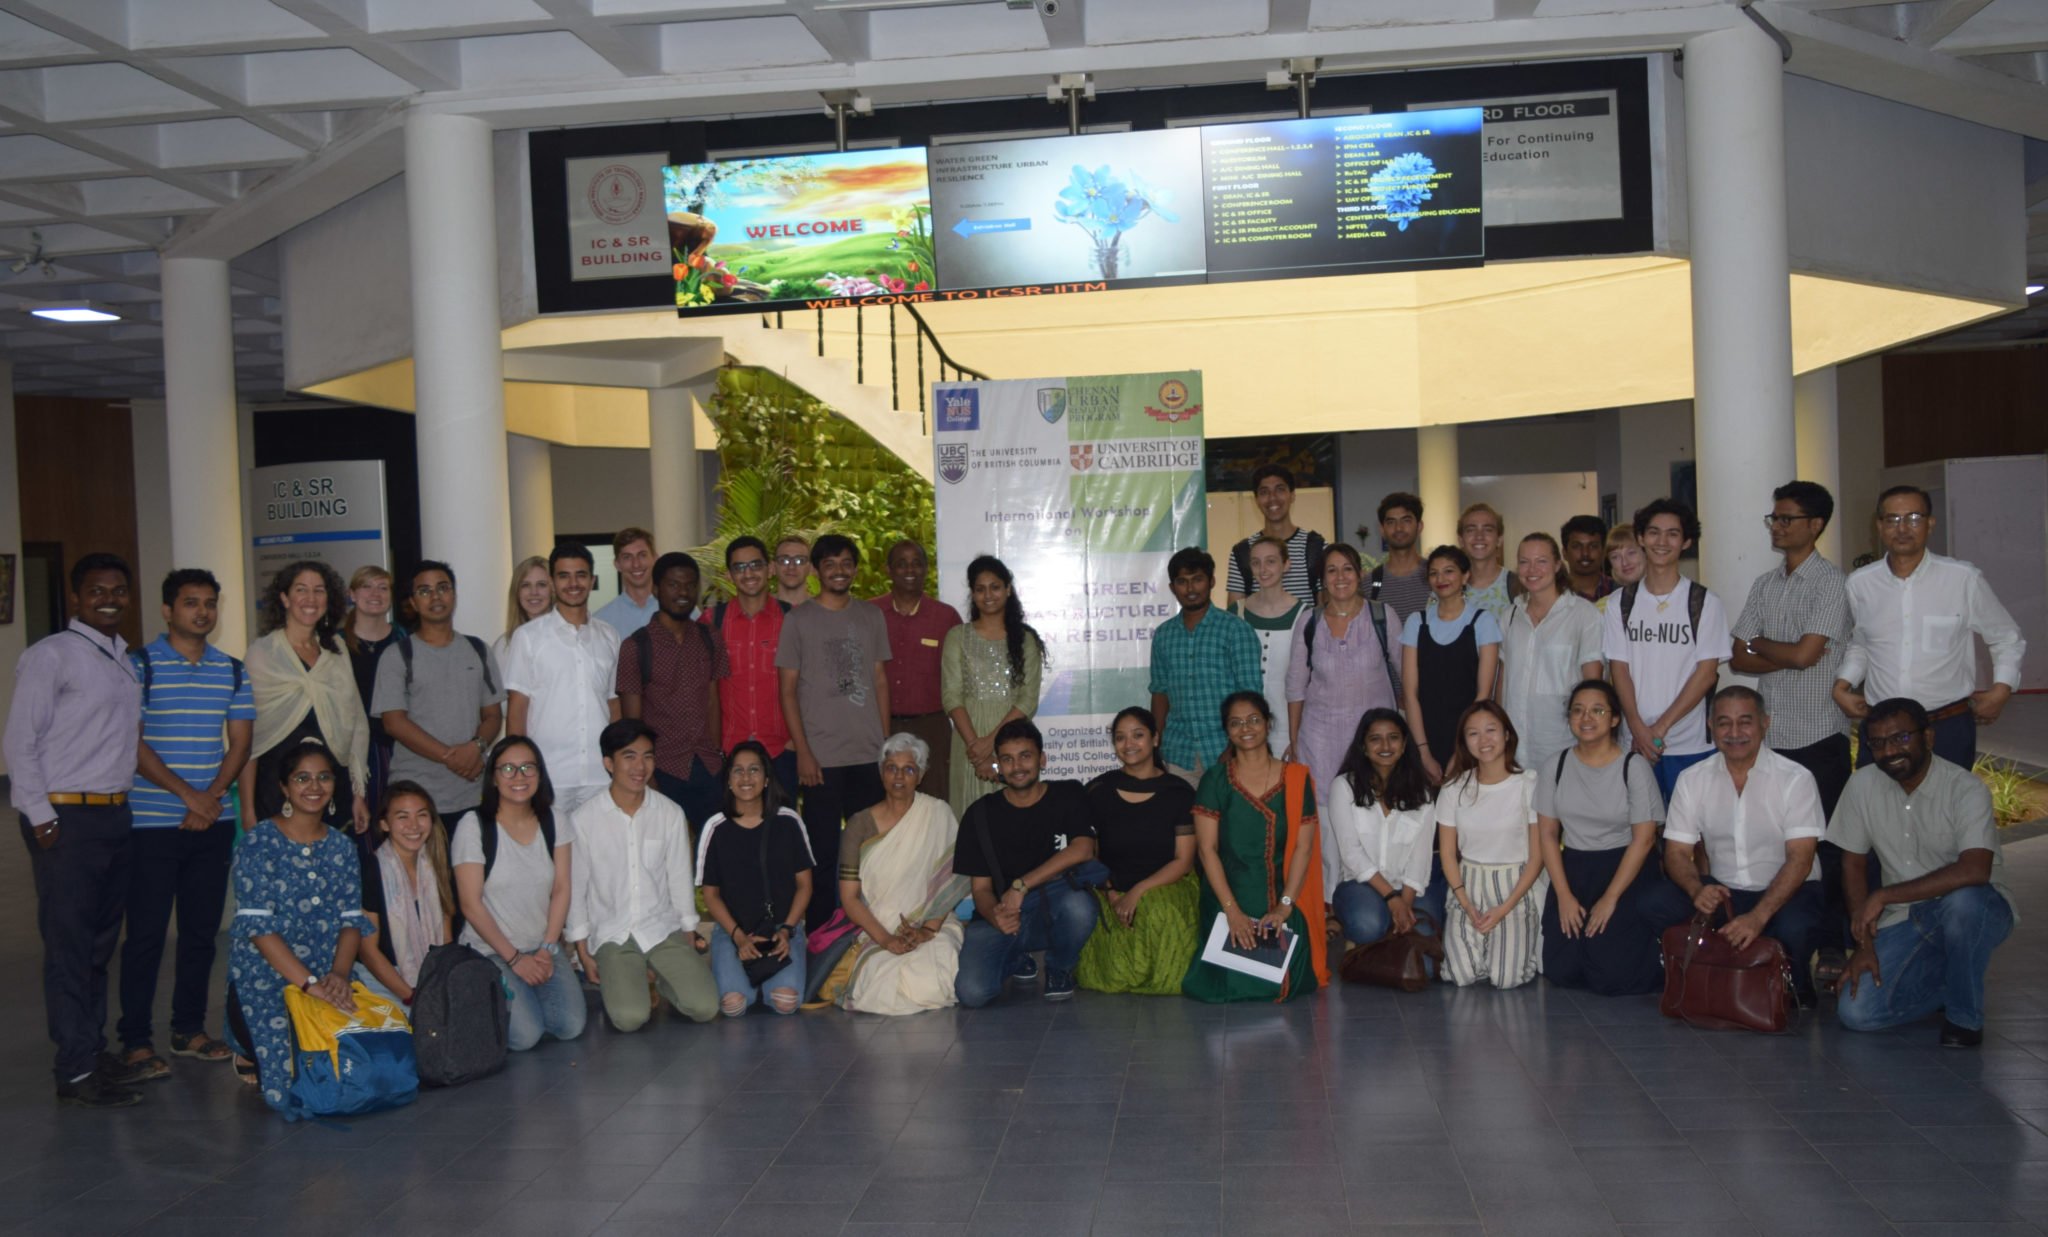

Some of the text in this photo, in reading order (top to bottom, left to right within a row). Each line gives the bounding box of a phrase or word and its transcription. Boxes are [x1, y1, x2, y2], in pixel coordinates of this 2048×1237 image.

[1483, 103, 1576, 120] RD FLOOR
[1487, 131, 1594, 147] For Continuing
[935, 154, 998, 165] WATER GREEN
[1483, 149, 1550, 162] Education
[935, 160, 1049, 174] INFRASTRUCTURE URBAN
[1344, 160, 1369, 168] OFFICE
[936, 174, 985, 183] RESILIENCE
[1233, 182, 1259, 190] FLOOR
[1222, 200, 1268, 209] CONFERENCE
[1362, 204, 1388, 212] FLOOR
[1345, 214, 1373, 222] CENTER
[1438, 208, 1481, 216] EDUCATION
[1247, 217, 1278, 225] FACILITY
[746, 218, 863, 240] WELCOME
[1247, 226, 1279, 234] PROJECT
[1279, 223, 1318, 232] ACCOUNTS
[1370, 230, 1387, 238] CELL
[591, 236, 651, 249] IC & SR
[1247, 234, 1287, 242] COMPUTER
[1288, 232, 1312, 240] ROOM
[581, 251, 662, 266] BUILDING
[806, 282, 1107, 310] WELCOME TO ICSR-IITM
[945, 396, 971, 407] Yale
[946, 406, 971, 417] NUS
[946, 415, 972, 424] College
[940, 446, 966, 456] UBC
[970, 447, 1038, 457] THE UNIVERSITY
[1097, 440, 1199, 455] UNIVERSITY OF
[971, 458, 1061, 469] OF BRITISH COLUMBIA
[1098, 453, 1199, 470] CAMBRIDGE
[273, 478, 334, 498] IC & SR
[267, 498, 347, 520] BUILDING
[984, 505, 1150, 523] International Workshop
[1064, 527, 1082, 537] on
[1067, 628, 1156, 643] RESILIE
[1048, 726, 1102, 738] Organized
[1043, 738, 1109, 750] rsity of British
[1048, 751, 1117, 763] le-NUS Colleg
[1040, 766, 1074, 776] bridge
